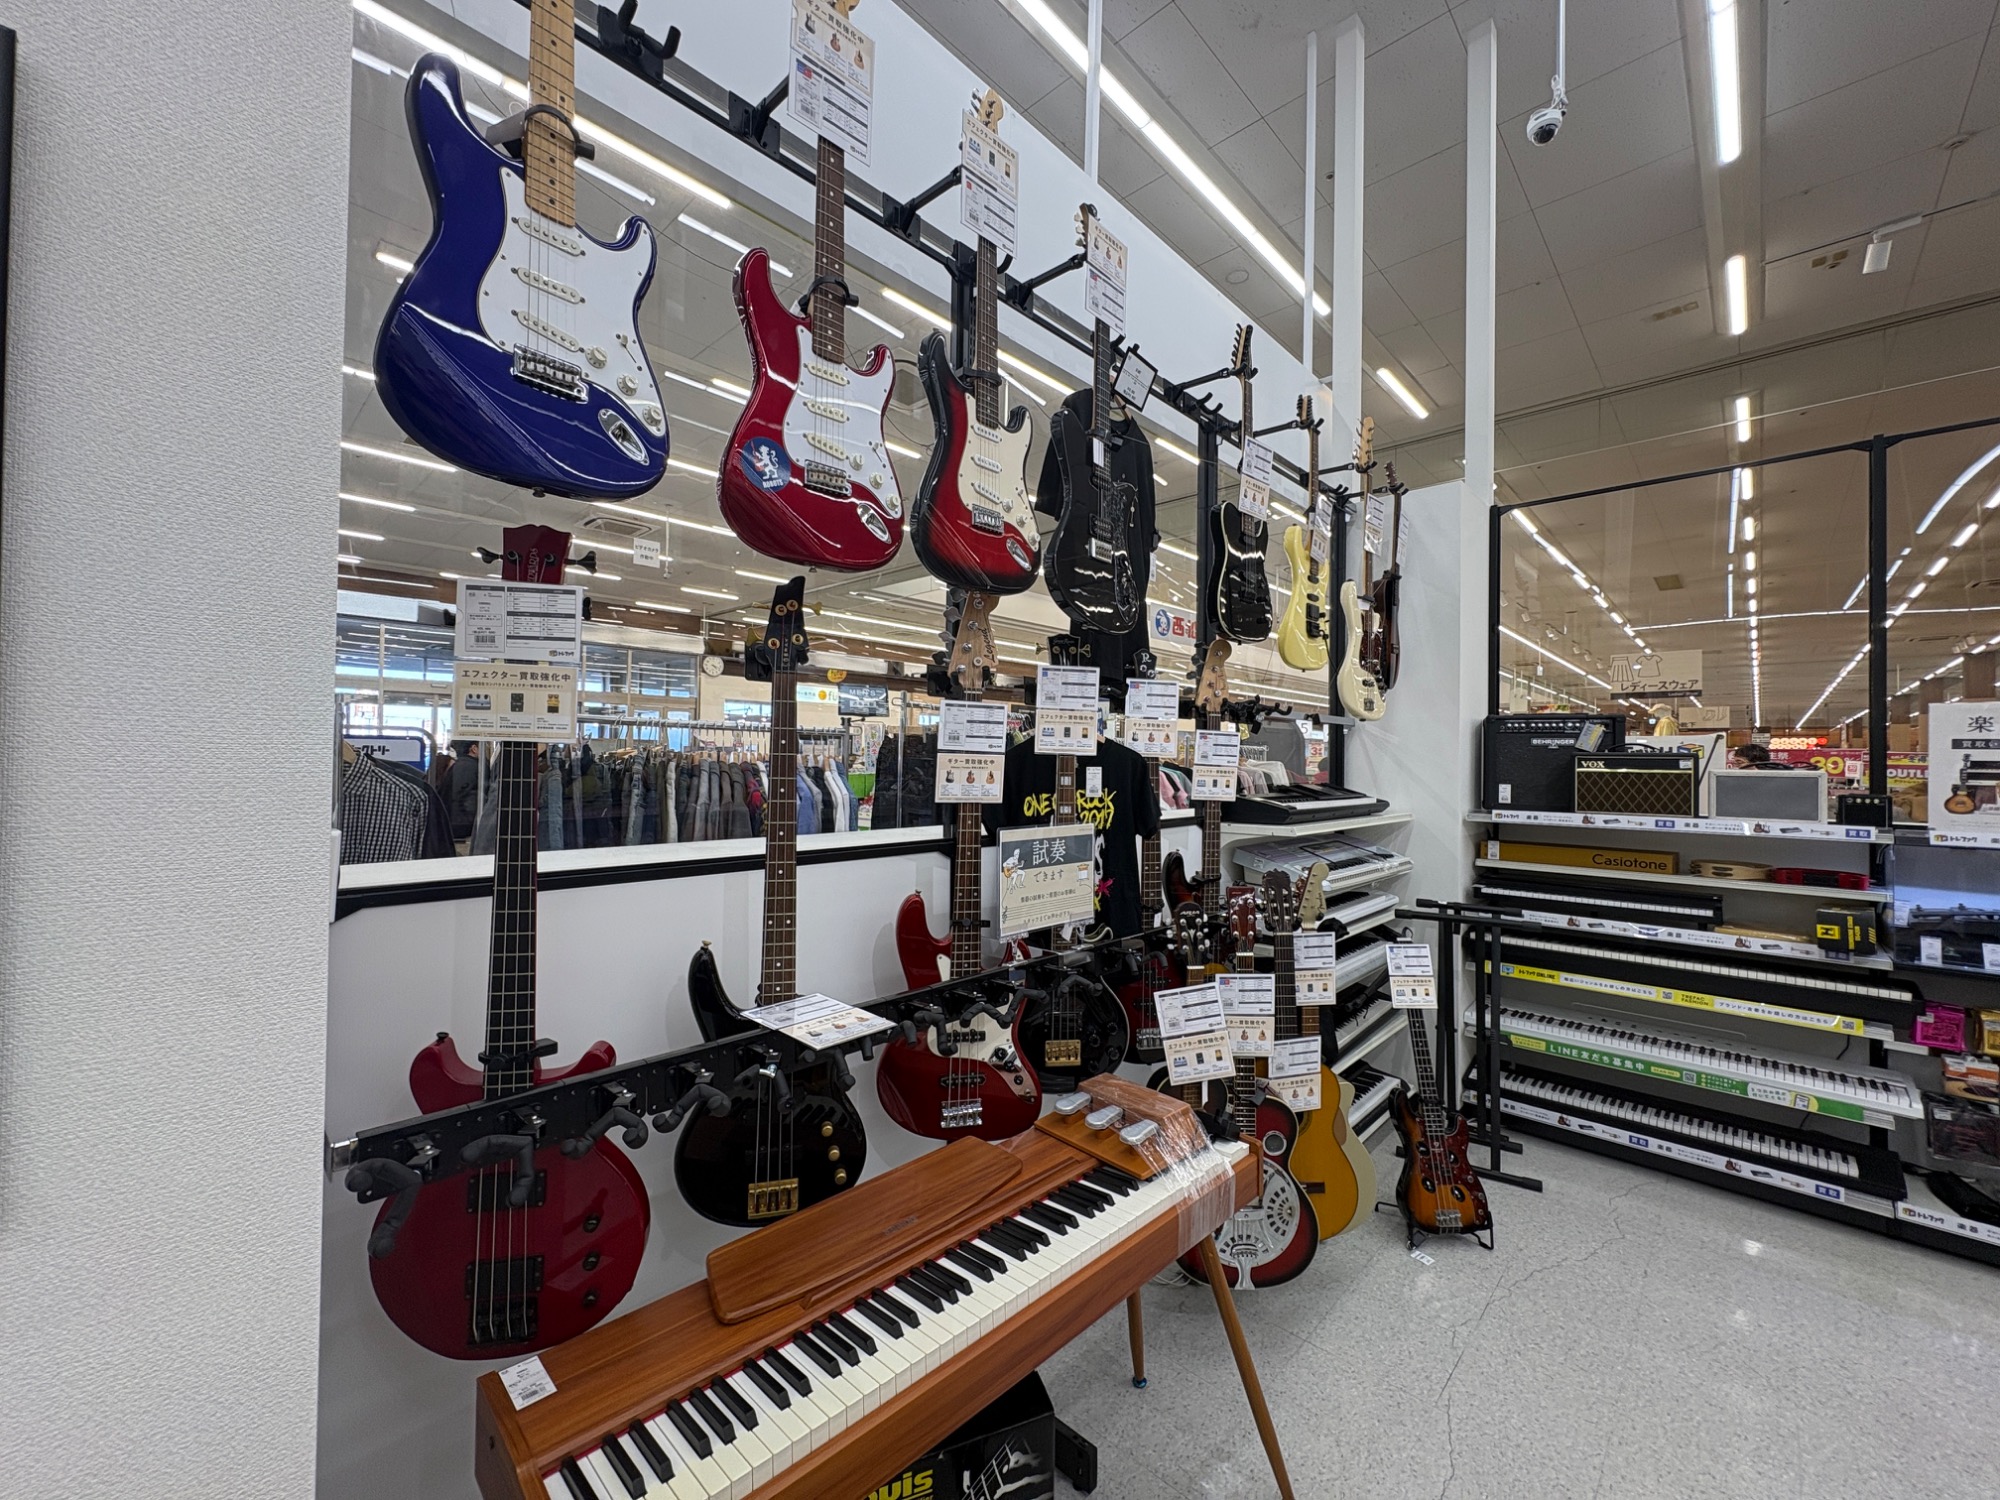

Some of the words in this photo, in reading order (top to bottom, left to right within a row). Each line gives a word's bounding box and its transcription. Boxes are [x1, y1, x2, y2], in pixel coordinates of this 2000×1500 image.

[462, 670, 571, 682] エフェクター買取強化中
[1621, 679, 1699, 692] レディースウェア
[1581, 760, 1605, 768] VOX
[1024, 793, 1051, 817] ONE
[1080, 809, 1114, 829] 2017
[1032, 838, 1066, 866] 試奏
[1592, 853, 1667, 871] Casiotone
[1034, 869, 1064, 882] できます
[1550, 1044, 1645, 1071] LINE友だち募集中
